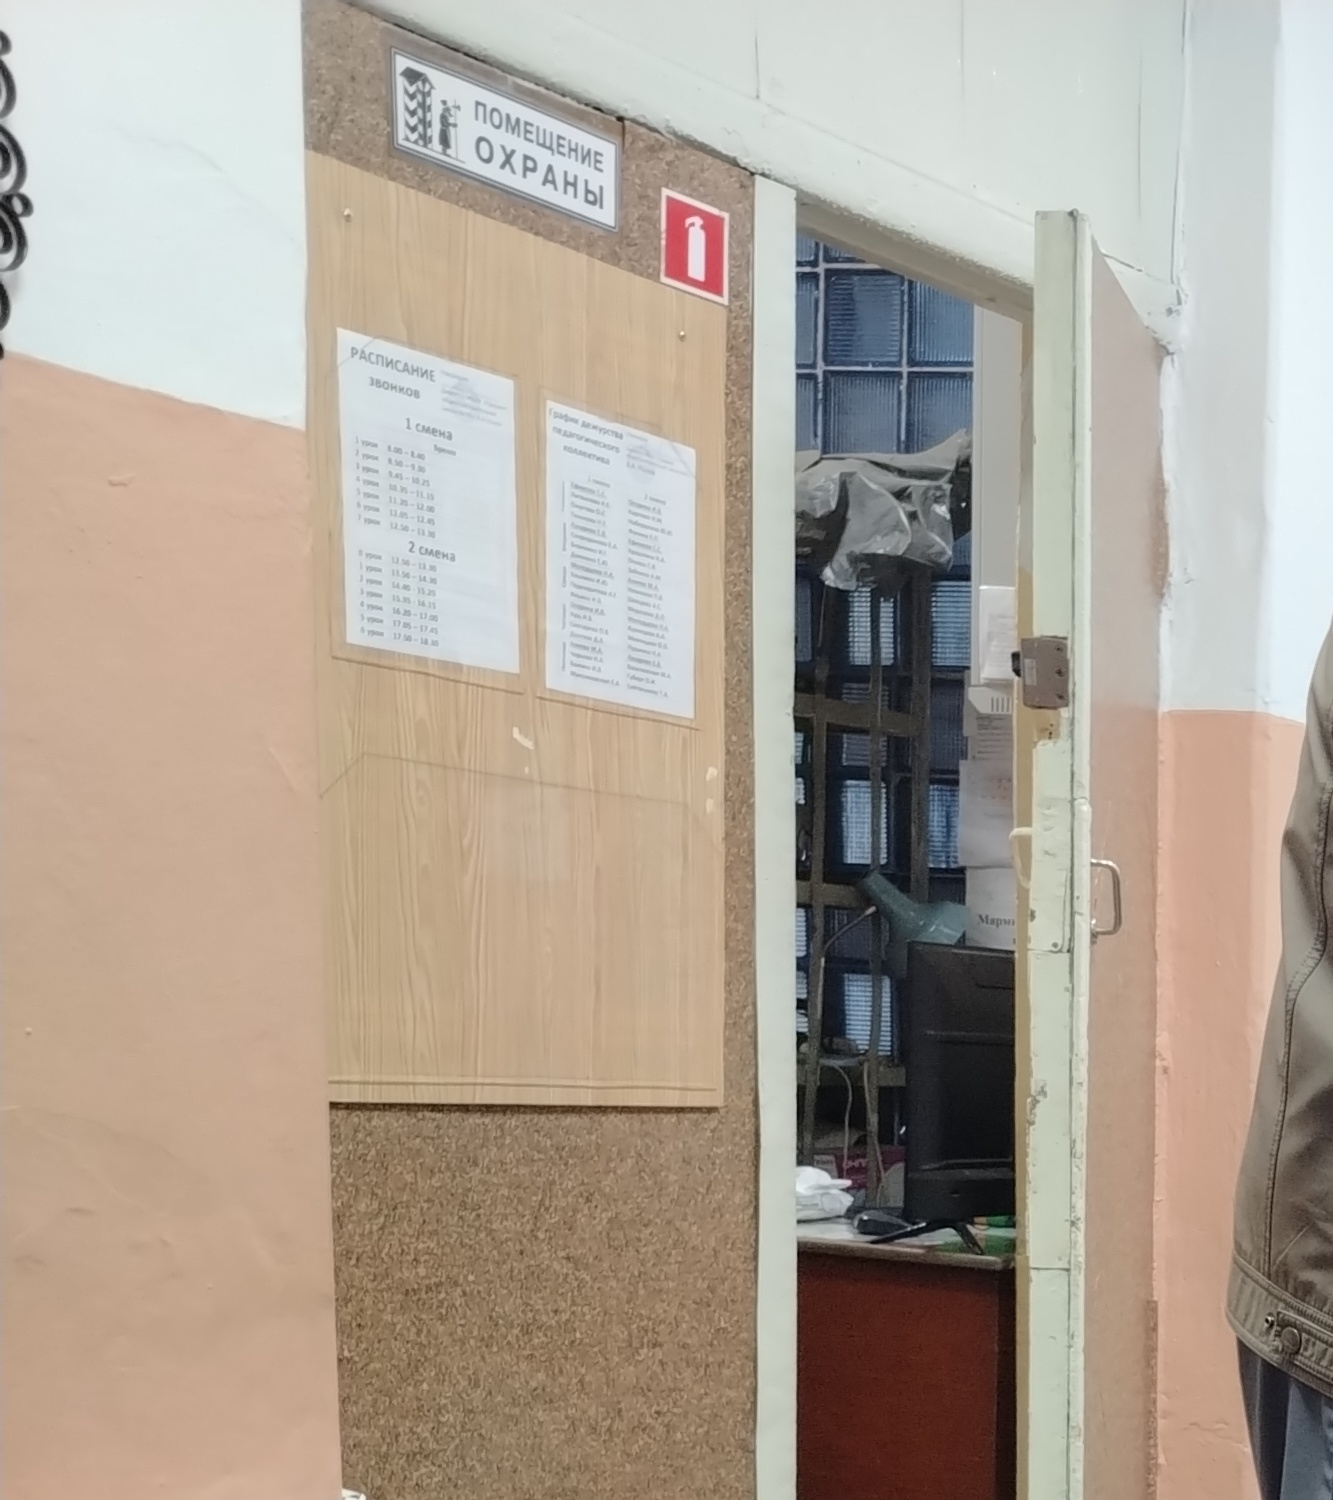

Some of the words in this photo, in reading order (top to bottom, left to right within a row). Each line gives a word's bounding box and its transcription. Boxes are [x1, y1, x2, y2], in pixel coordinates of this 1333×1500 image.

[473, 99, 605, 173] ПОМЕЩЕНИЕ
[474, 135, 605, 211] ОХРАНЫ
[350, 346, 436, 383] РАСПИСАНИЕ
[369, 376, 421, 400] звонков
[405, 416, 412, 431] 1
[415, 422, 453, 441] смена
[408, 540, 415, 554] 2
[418, 545, 457, 563] смена
